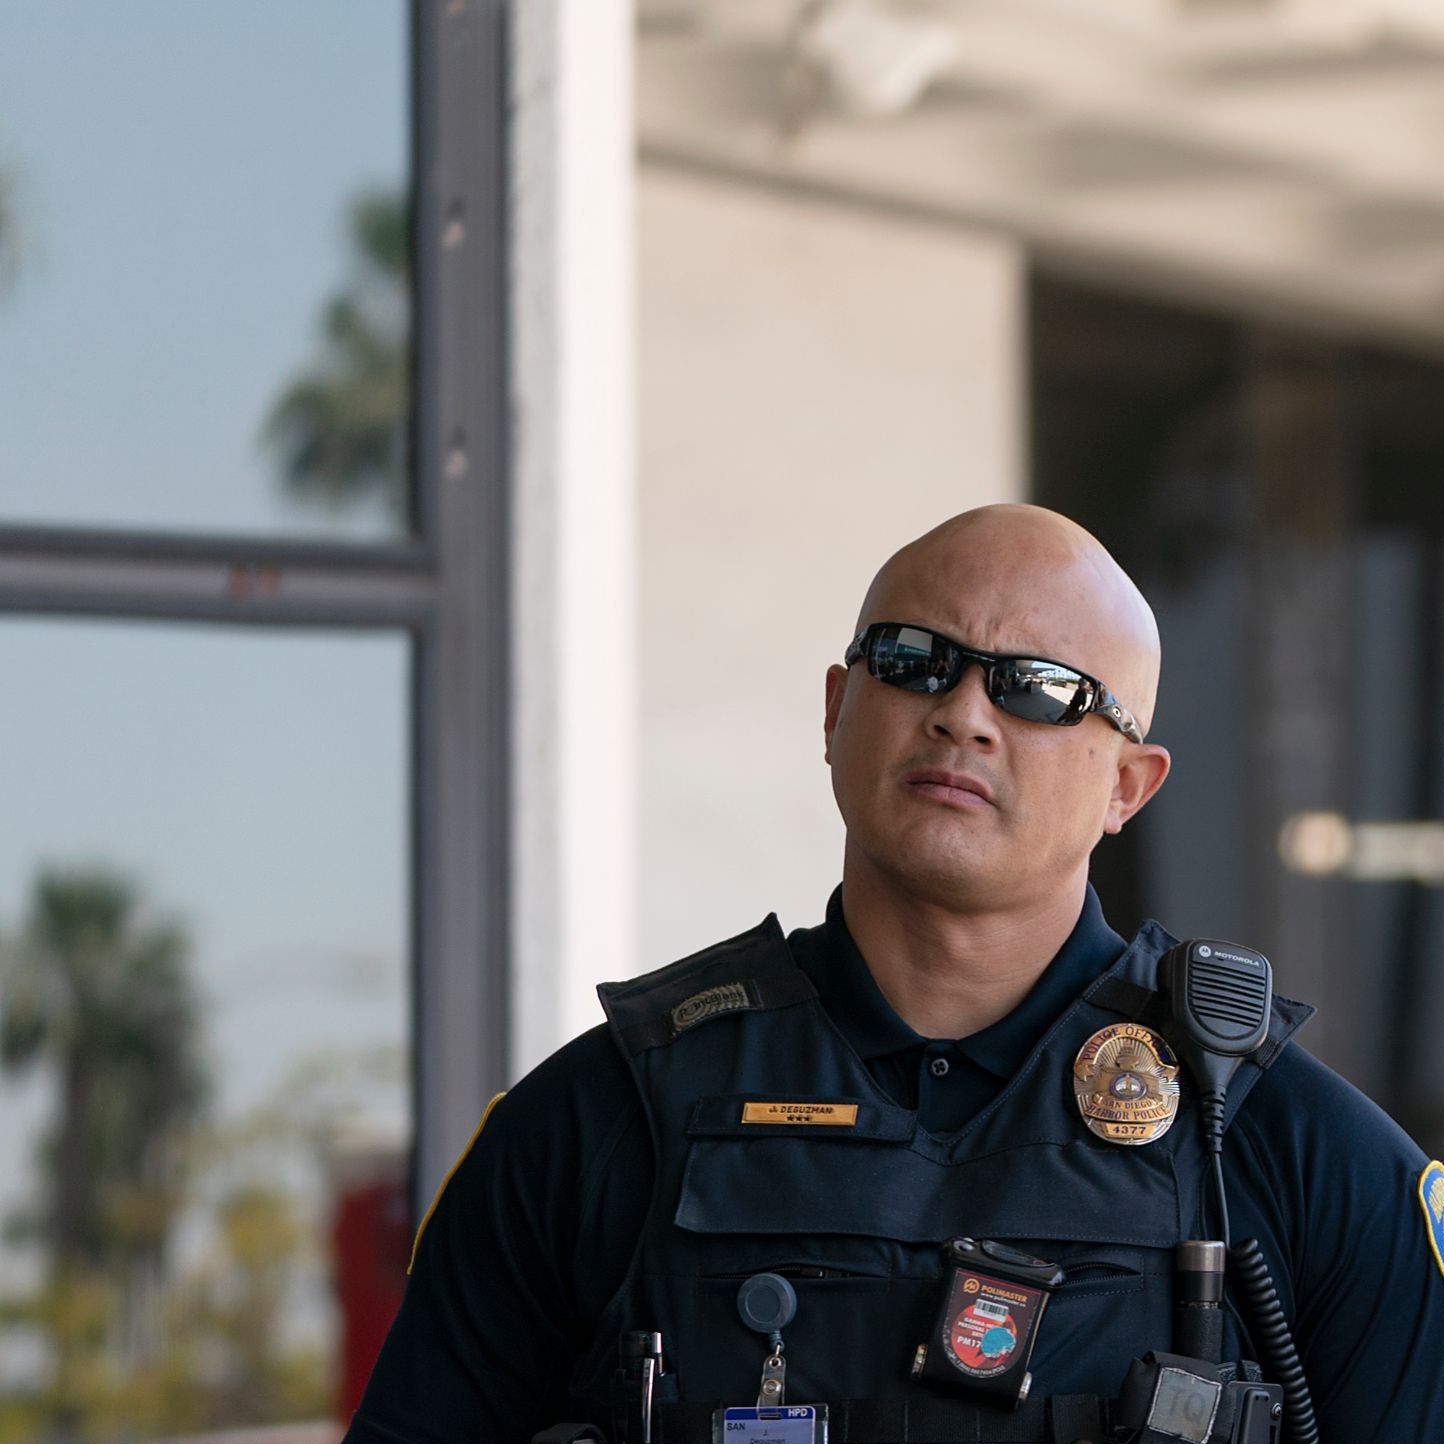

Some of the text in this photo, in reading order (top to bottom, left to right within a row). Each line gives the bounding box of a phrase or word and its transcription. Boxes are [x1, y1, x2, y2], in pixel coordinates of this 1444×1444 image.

[1214, 951, 1260, 967] MOTOROLA
[1083, 1027, 1119, 1060] POLICE
[1125, 1099, 1153, 1109] DIEGO
[780, 1105, 833, 1114] DEGUZMAN
[1087, 1104, 1168, 1120] HARBOR POLICE
[1113, 1126, 1146, 1135] 4377
[981, 1284, 1028, 1302] POLIMASTER
[788, 1408, 808, 1417] HPD
[726, 1422, 746, 1431] SAN
